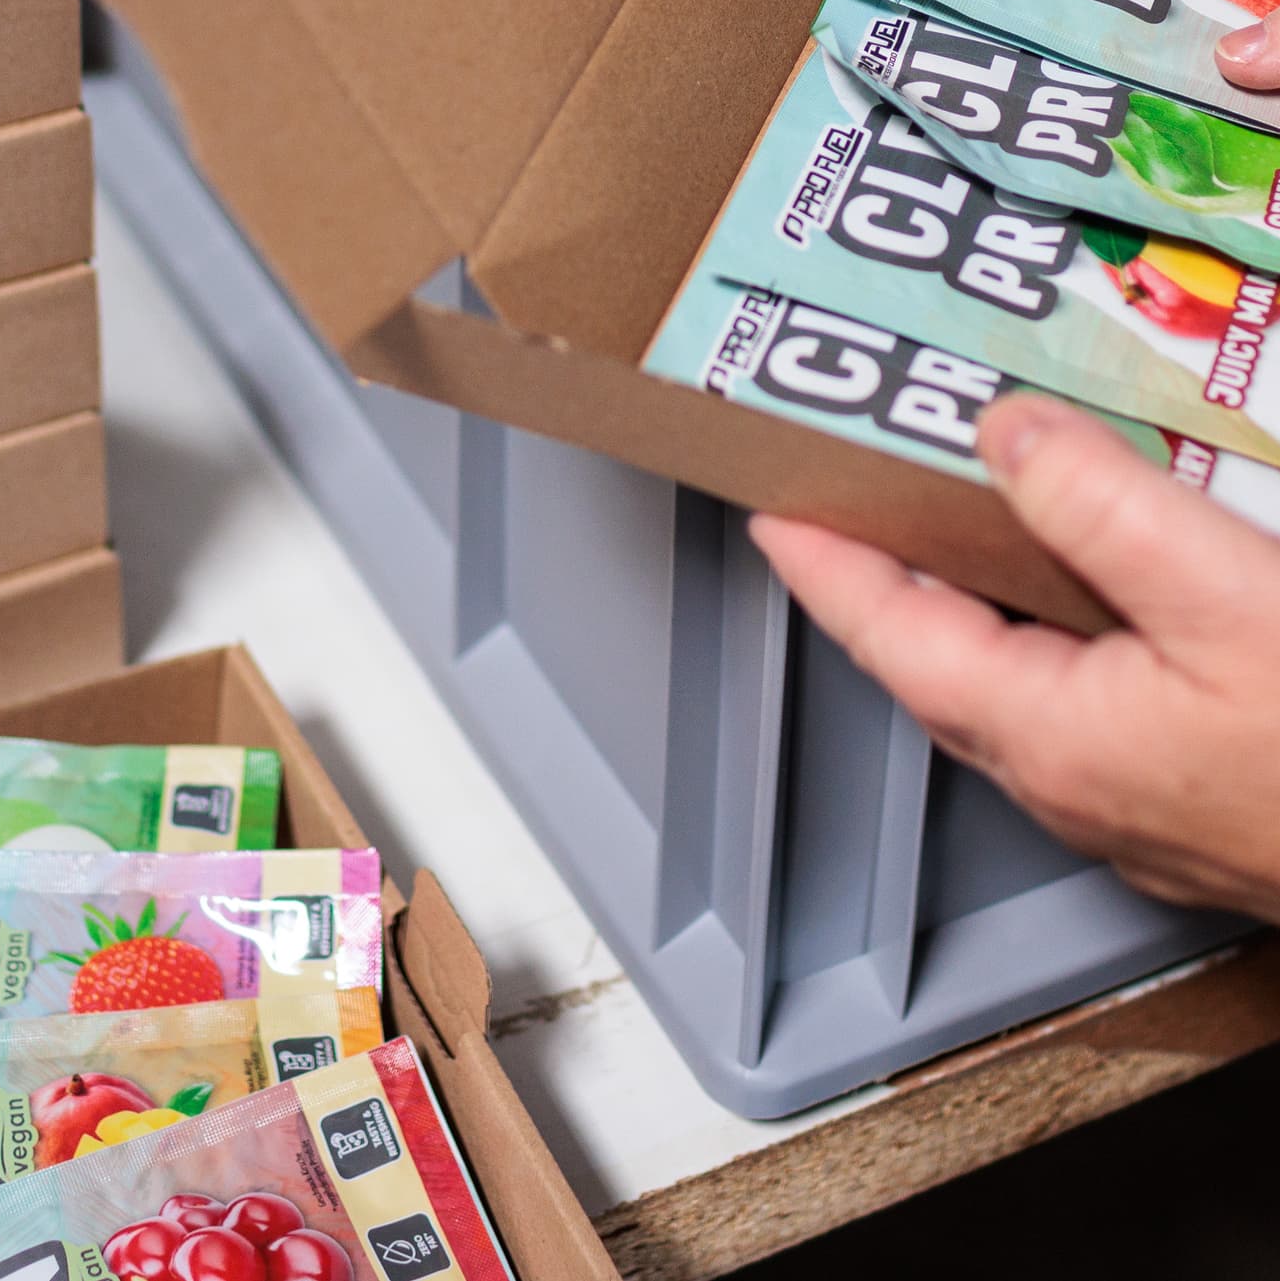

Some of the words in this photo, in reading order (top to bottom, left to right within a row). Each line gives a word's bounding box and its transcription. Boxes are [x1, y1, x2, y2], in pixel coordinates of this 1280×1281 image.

[863, 18, 903, 63] FUEL
[792, 171, 831, 219] PRO
[813, 128, 857, 174] FUEL
[718, 316, 758, 366] PRO
[1206, 324, 1261, 406] JUICY
[2, 932, 26, 1001] vegan
[10, 1098, 33, 1174] vegan
[364, 1120, 383, 1149] TASTY
[369, 1101, 399, 1157] REFRESHING
[414, 1234, 431, 1257] ZERO
